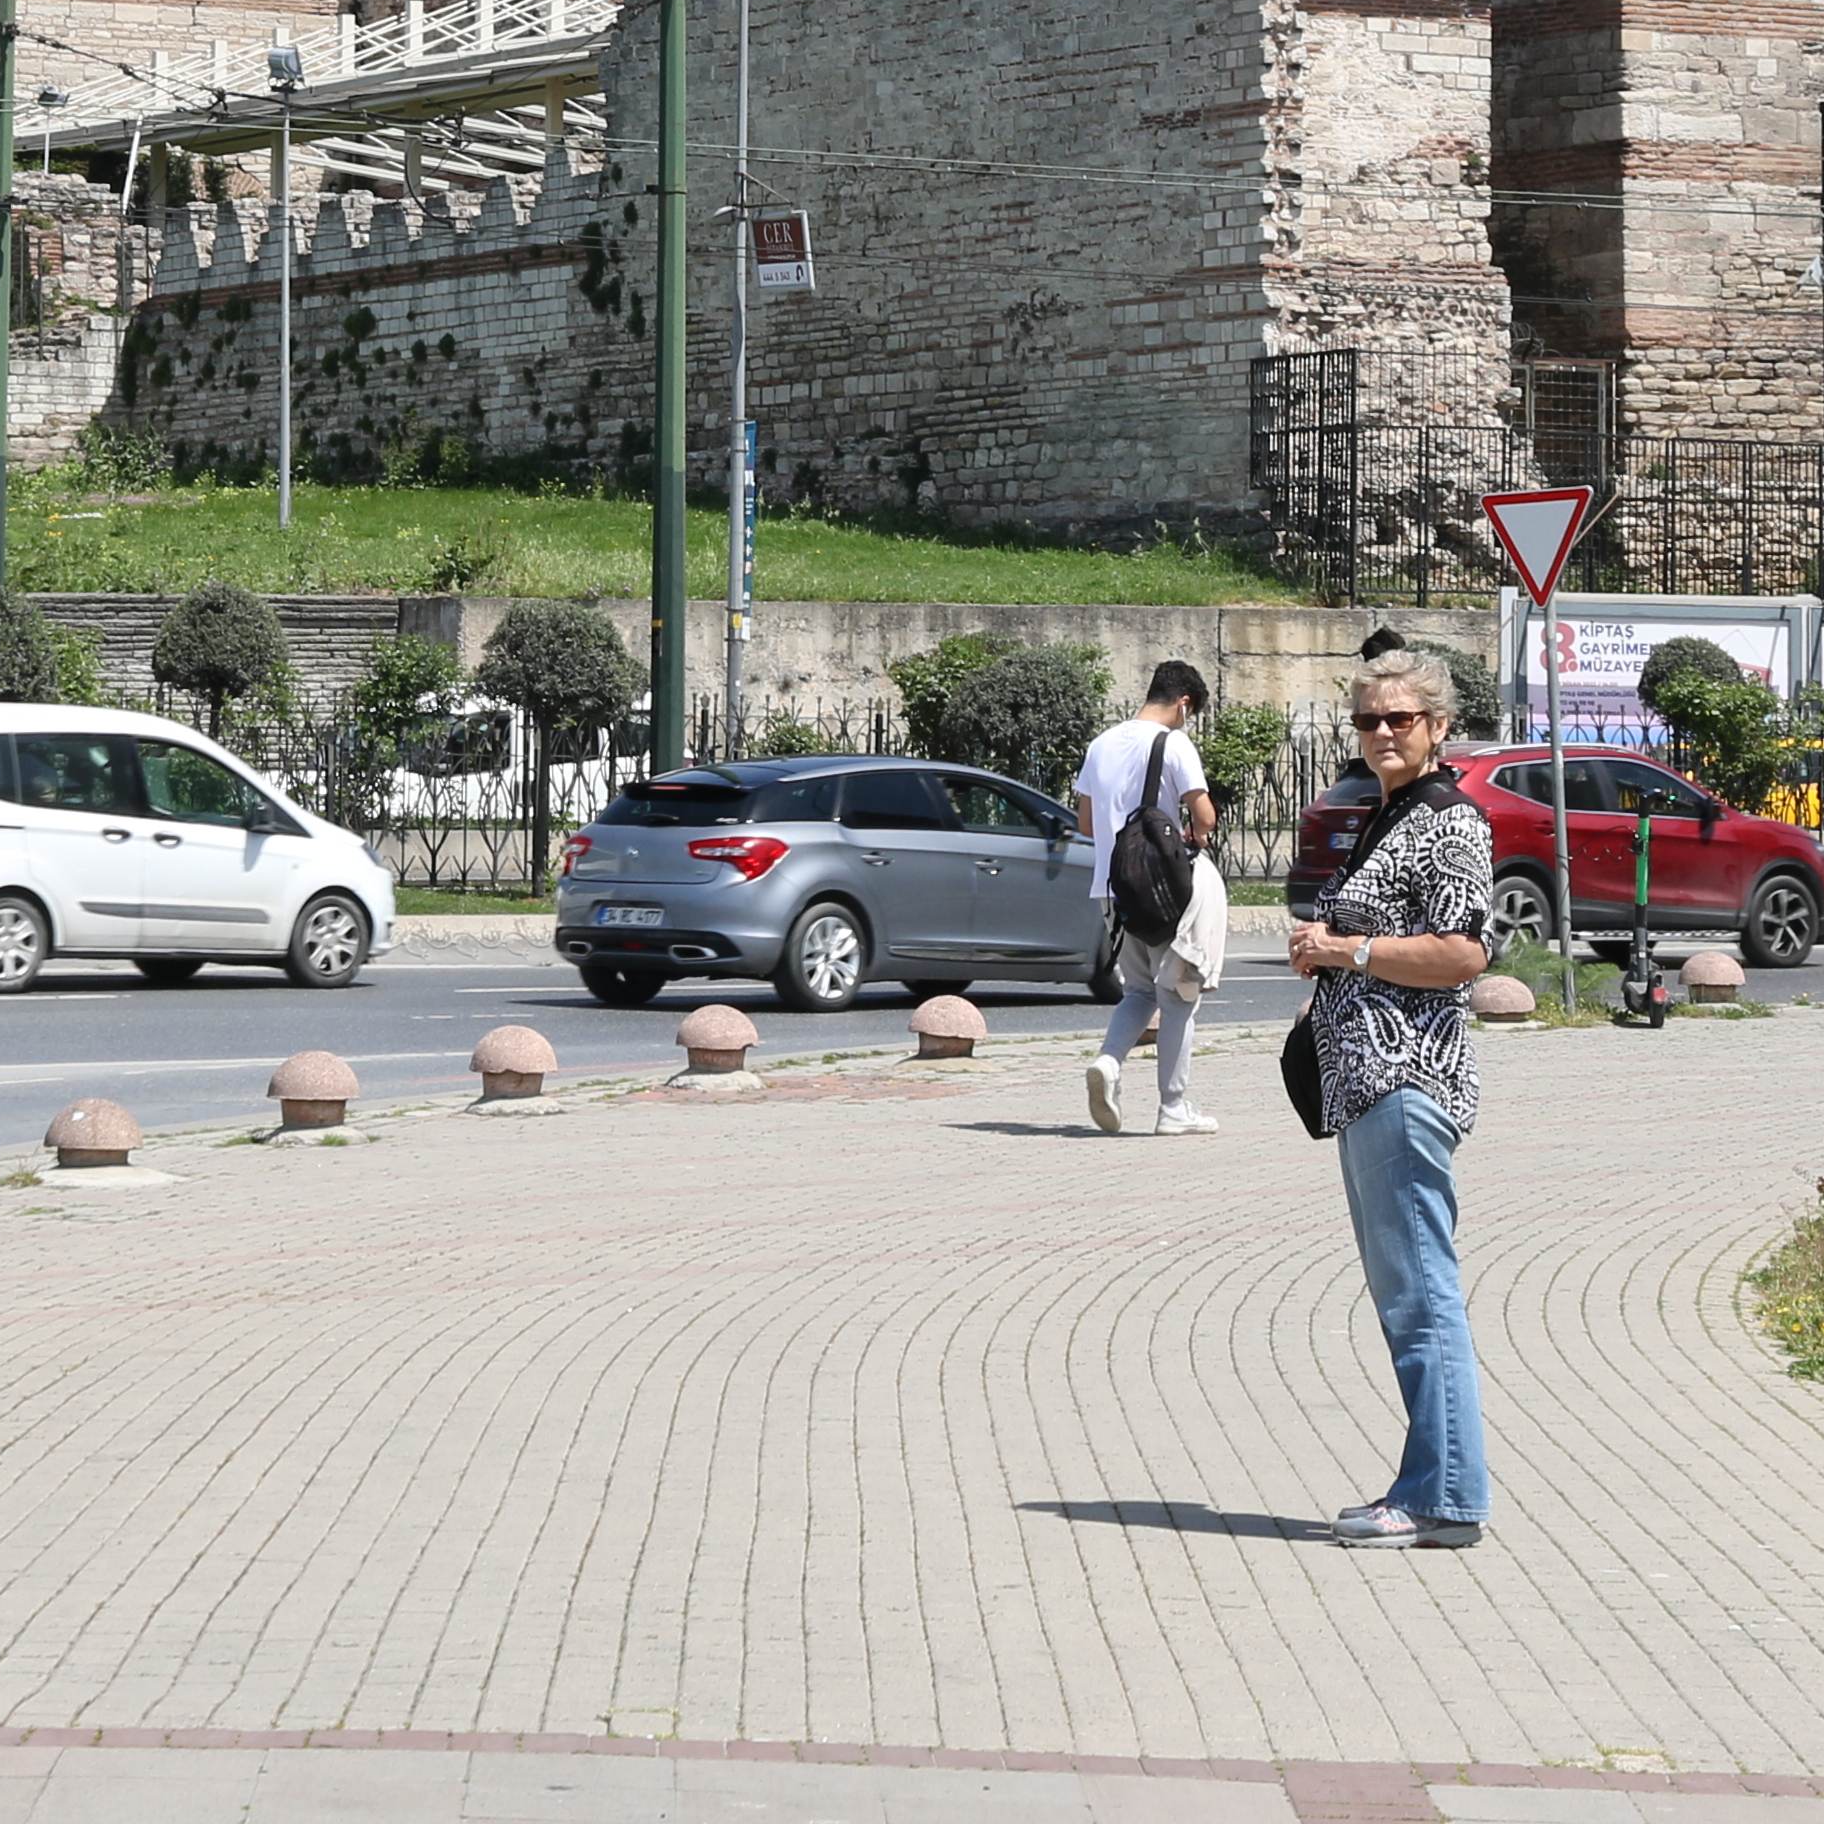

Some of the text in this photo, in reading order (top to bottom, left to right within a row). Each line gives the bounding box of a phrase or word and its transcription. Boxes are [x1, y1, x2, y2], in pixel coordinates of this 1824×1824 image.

[763, 222, 793, 244] CER
[1579, 620, 1634, 639] KİPTAŞ
[1580, 640, 1653, 656] GAYRİME
[1579, 657, 1643, 673] MÜZAYE
